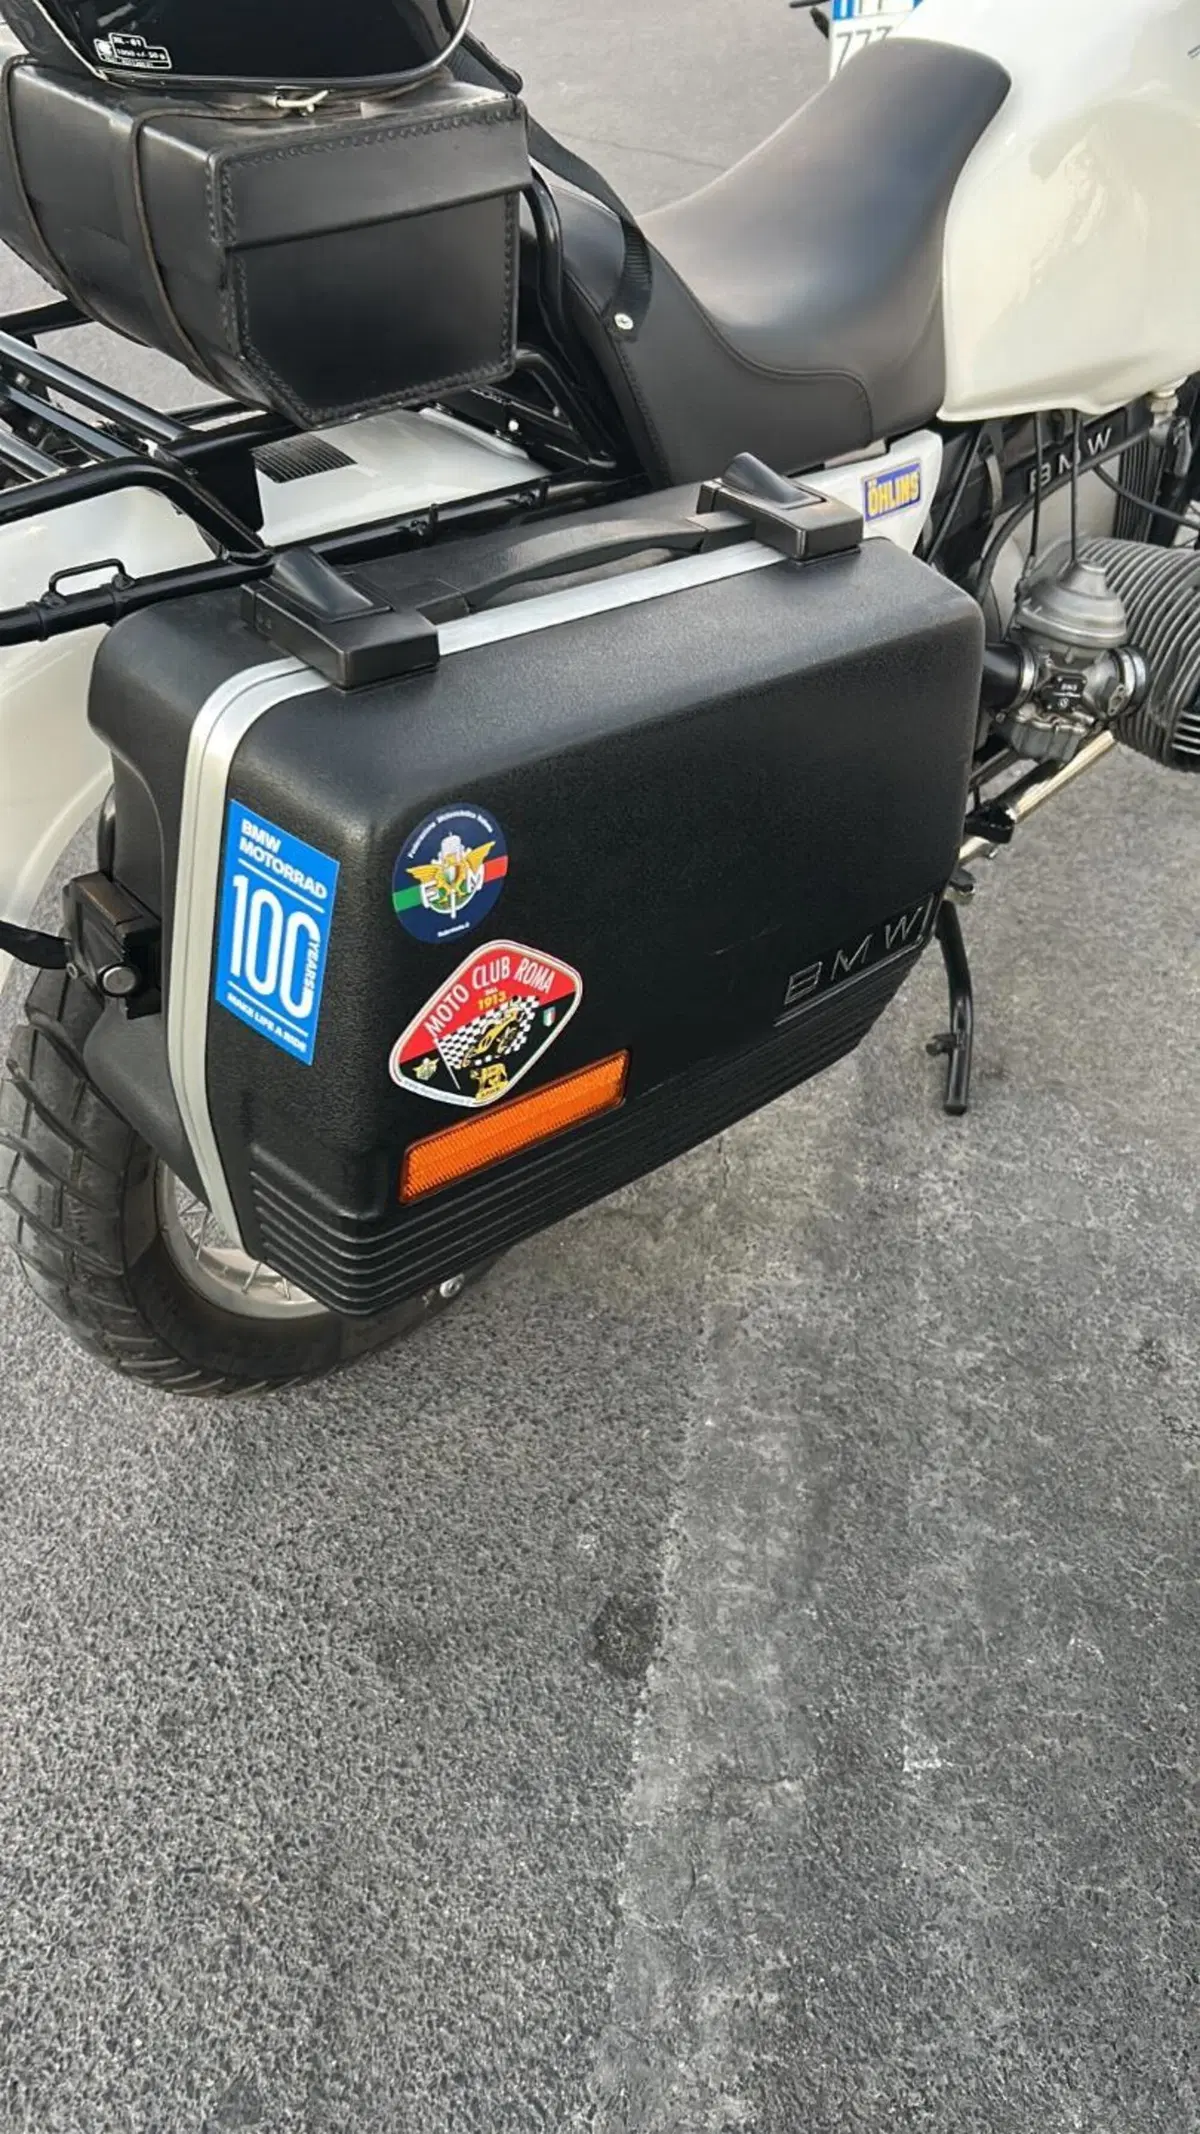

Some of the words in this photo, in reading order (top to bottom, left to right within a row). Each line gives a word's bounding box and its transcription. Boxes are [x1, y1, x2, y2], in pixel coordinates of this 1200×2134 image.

[241, 818, 282, 853] BMW
[239, 836, 328, 899] MOTORRAD
[230, 873, 322, 1019] 100
[304, 940, 321, 991] YEARS
[784, 905, 924, 1005] BMW
[423, 983, 470, 1037] MOTO
[471, 956, 511, 990] CLUB
[513, 957, 556, 994] ROMA
[478, 991, 508, 1011] 1913
